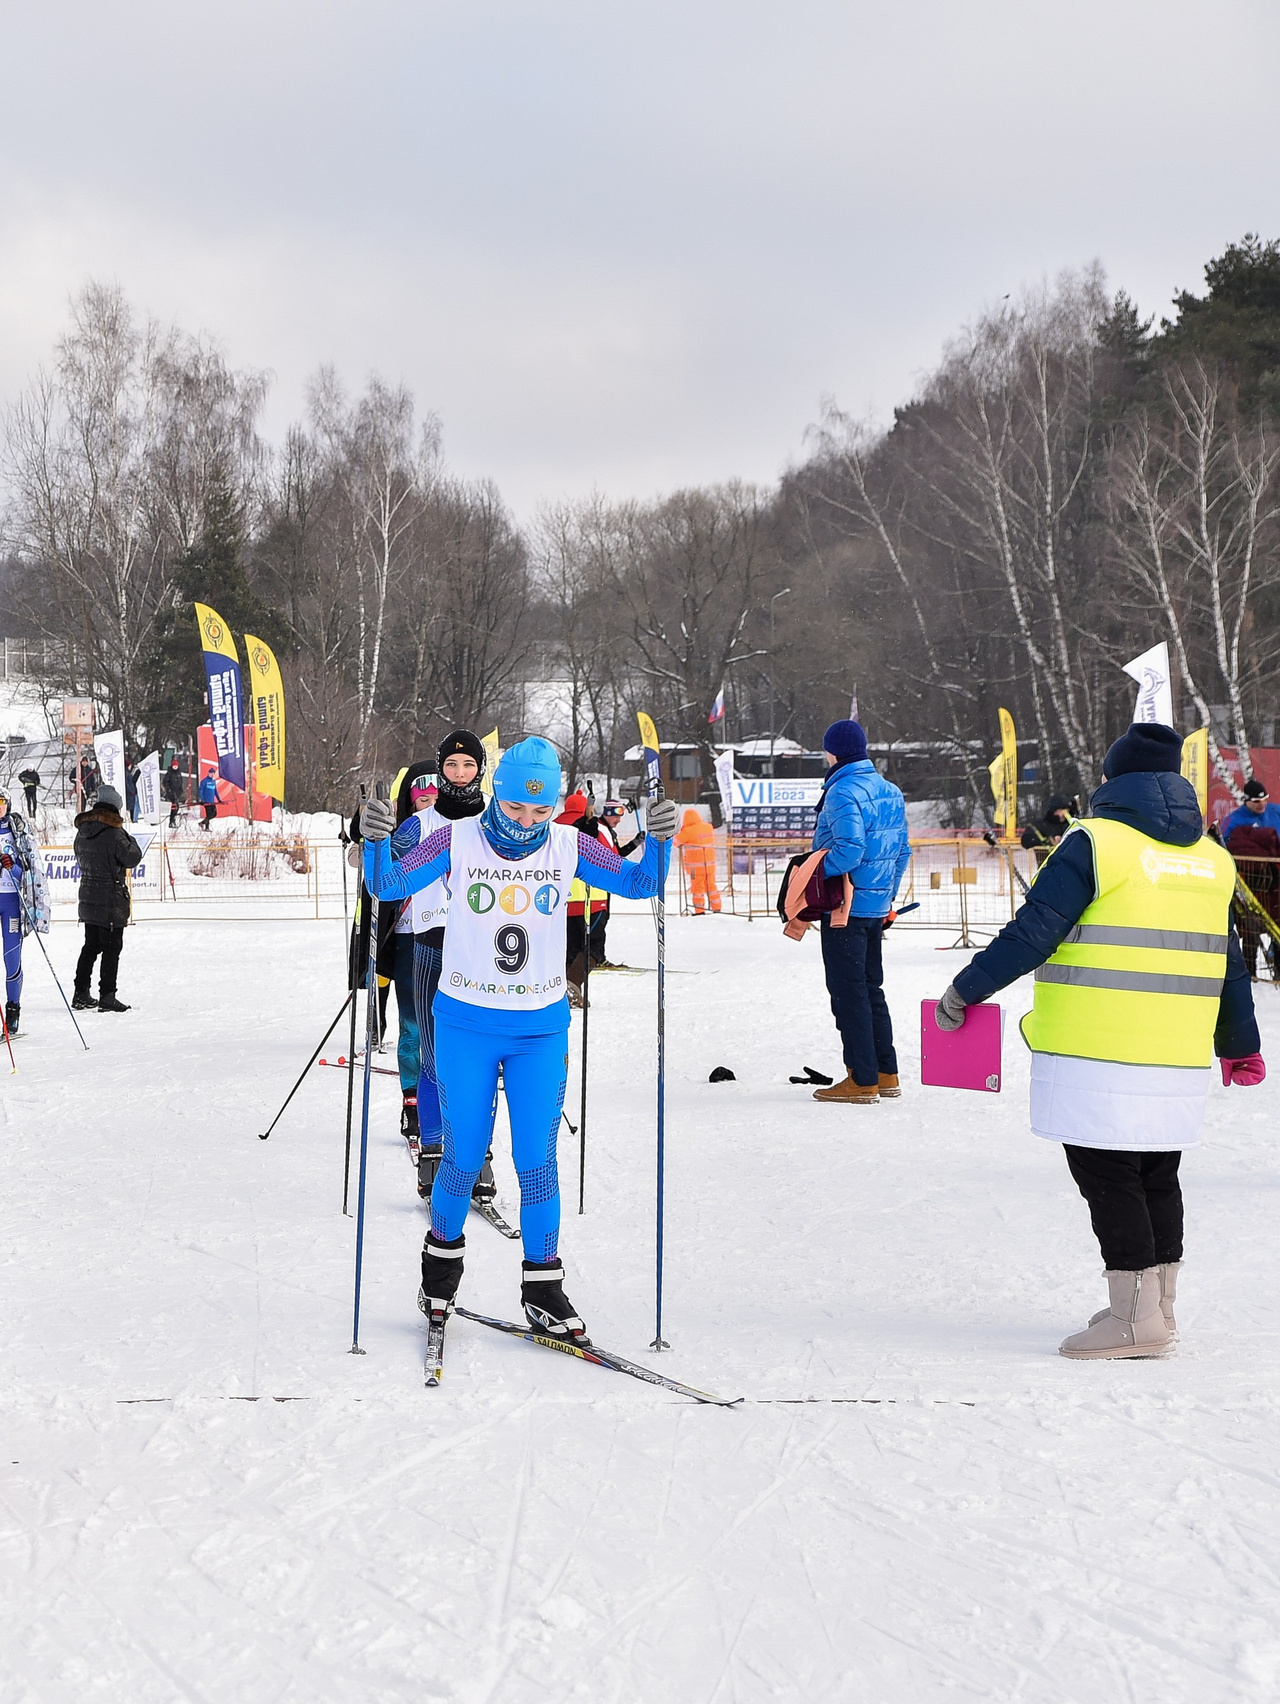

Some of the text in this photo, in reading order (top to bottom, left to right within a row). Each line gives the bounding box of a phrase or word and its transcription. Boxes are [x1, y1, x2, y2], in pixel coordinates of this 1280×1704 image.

[737, 782, 773, 804] VII
[774, 791, 805, 801] 2023
[44, 853, 77, 863] Спорт
[467, 867, 562, 882] VMARAFONE
[494, 923, 529, 975] 9
[537, 1337, 577, 1355] SALOMON
